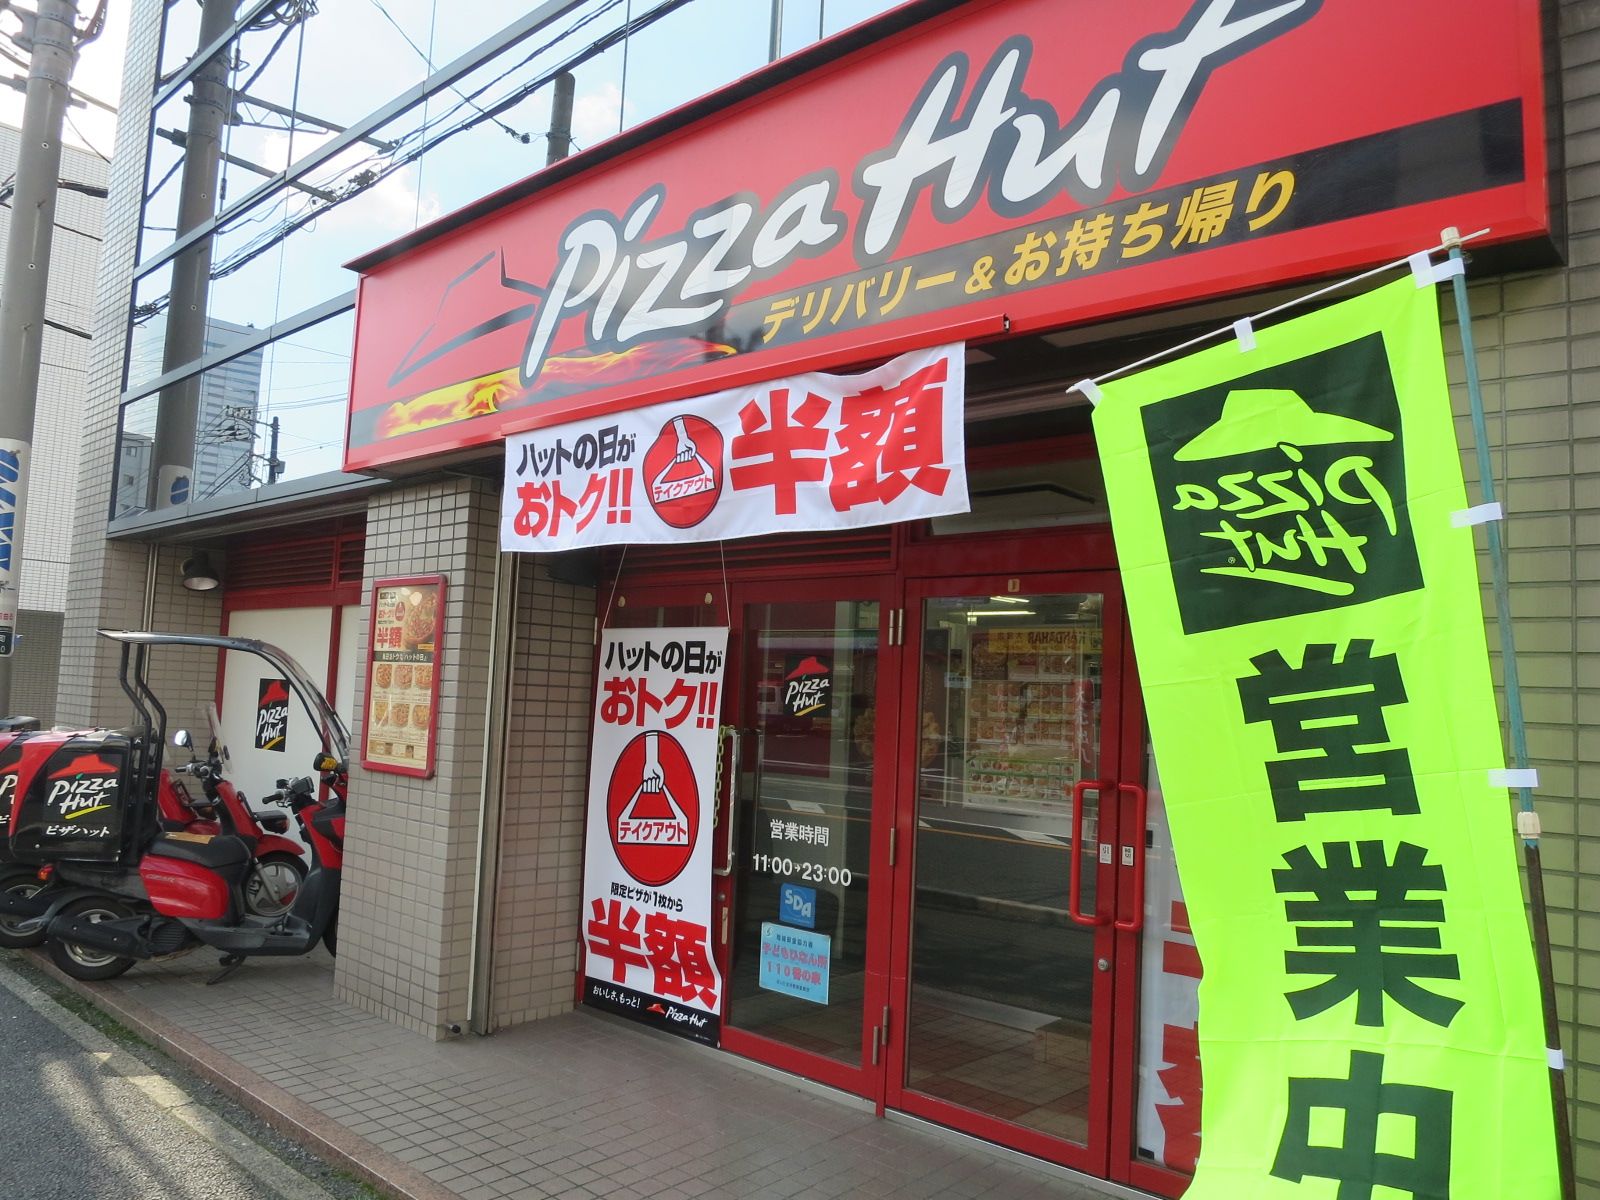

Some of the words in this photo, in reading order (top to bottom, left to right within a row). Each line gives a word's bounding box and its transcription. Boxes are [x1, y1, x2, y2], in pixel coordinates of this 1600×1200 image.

[526, 180, 838, 378] Pizza
[863, 0, 1306, 255] Hut
[762, 168, 1297, 344] デリバリー&お持ち帰り
[515, 424, 637, 477] ハットの日が
[729, 357, 951, 516] 半額
[513, 467, 634, 538] おトク!!
[653, 474, 713, 501] テイクアウト
[604, 640, 723, 675] ハットの日が
[600, 676, 719, 730] おトク!!
[785, 674, 831, 705] Pizza
[793, 692, 825, 713] Hut
[256, 702, 289, 737] Pizza
[261, 721, 284, 746] Hut
[47, 773, 119, 806] Pizza
[59, 791, 111, 815] Hut
[619, 821, 687, 842] テイクアウト
[769, 818, 830, 847] 営業時間
[752, 853, 793, 877] 11:00
[801, 861, 852, 887] 23:00
[784, 889, 812, 918] SDA
[587, 896, 718, 1011] 半額
[665, 1006, 689, 1022] Pizza
[689, 1012, 708, 1028] Hut
